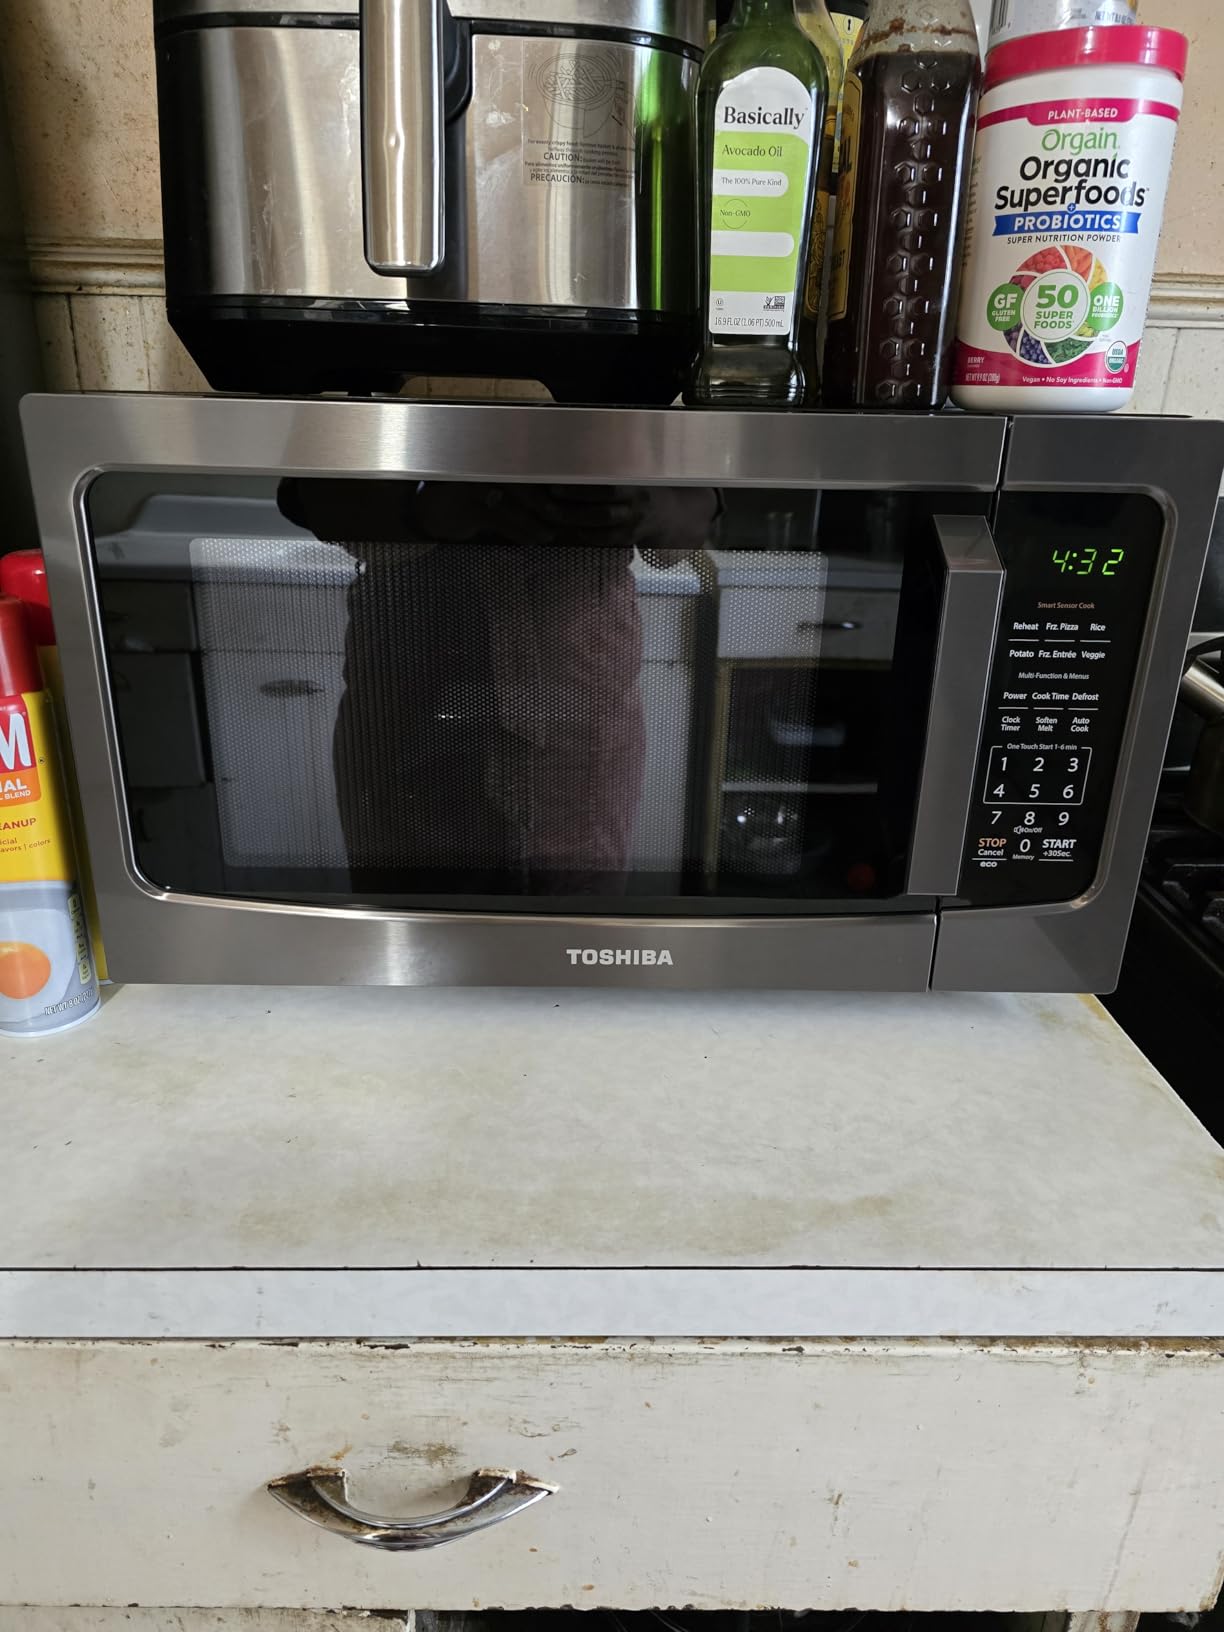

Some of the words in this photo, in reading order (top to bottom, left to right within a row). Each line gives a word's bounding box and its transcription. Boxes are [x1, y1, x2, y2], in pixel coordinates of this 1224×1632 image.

[724, 106, 804, 130] Basically
[1048, 108, 1118, 120] PLANT-BASED
[1041, 127, 1118, 156] Orgain
[544, 152, 582, 162] CAUTION:
[722, 144, 766, 156] Avocado
[769, 146, 782, 157] Oil
[1020, 153, 1130, 183] Organic
[995, 179, 1145, 212] Superfoods
[1014, 214, 1121, 231] PROBIOTICS
[1007, 236, 1032, 244] SUPER
[1087, 234, 1120, 242] POWDER
[994, 294, 1017, 308] GF
[1036, 284, 1078, 308] 50
[1094, 295, 1120, 306] ONE
[1036, 311, 1073, 319] SUPER
[727, 317, 733, 326] FL
[765, 319, 775, 327] 500
[776, 319, 784, 327] mL
[1034, 321, 1072, 329] FOODS
[1052, 549, 1124, 575] 4:32
[1082, 651, 1105, 660] Veggie
[1001, 757, 1007, 771] 1
[1033, 757, 1044, 772] 2
[1067, 758, 1078, 772] 3
[4, 790, 32, 800] BLEND
[993, 784, 1005, 798] 4
[1029, 784, 1040, 798] 5
[1063, 784, 1074, 798] 6
[991, 811, 1002, 824] 7
[1024, 812, 1035, 825] 8
[1058, 812, 1069, 825] 9
[978, 838, 1007, 847] STOP
[1020, 839, 1030, 852] 0
[1042, 839, 1076, 848] START
[566, 949, 673, 965] TOSHIBA
[45, 1006, 58, 1015] NET
